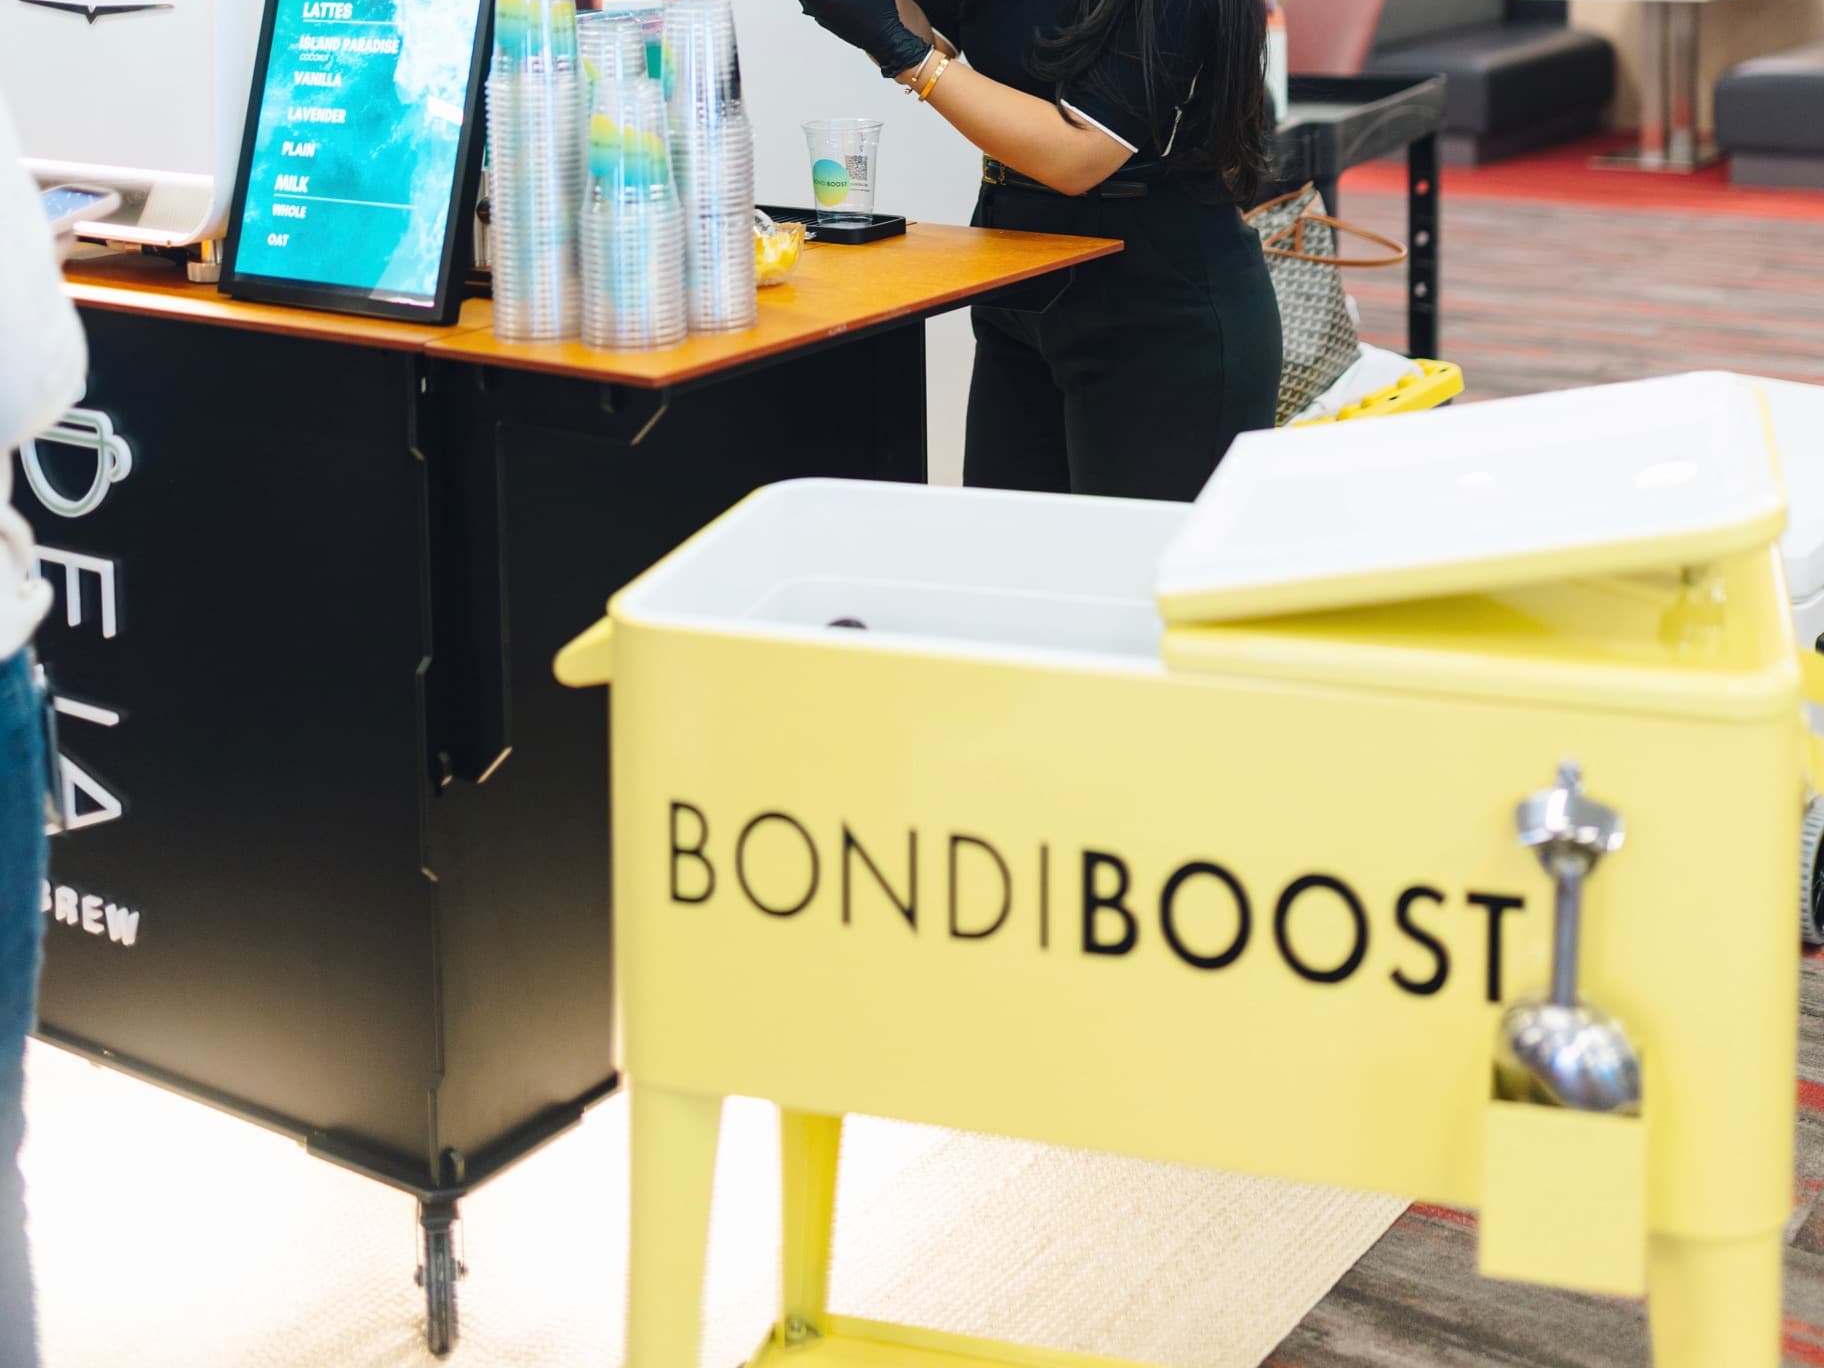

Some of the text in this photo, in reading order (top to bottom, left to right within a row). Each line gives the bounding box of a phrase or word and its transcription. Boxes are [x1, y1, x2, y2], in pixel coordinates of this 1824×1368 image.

[302, 1, 353, 20] LATTES
[299, 34, 400, 54] ISLAND PARADISE
[294, 71, 342, 87] VANILLA
[287, 106, 346, 124] LAVENDER
[281, 141, 316, 158] PLAIN
[274, 174, 310, 193] MILK
[272, 203, 307, 219] WHOLE
[267, 233, 289, 247] OAT
[669, 798, 1528, 1003] BONDIBOOST
